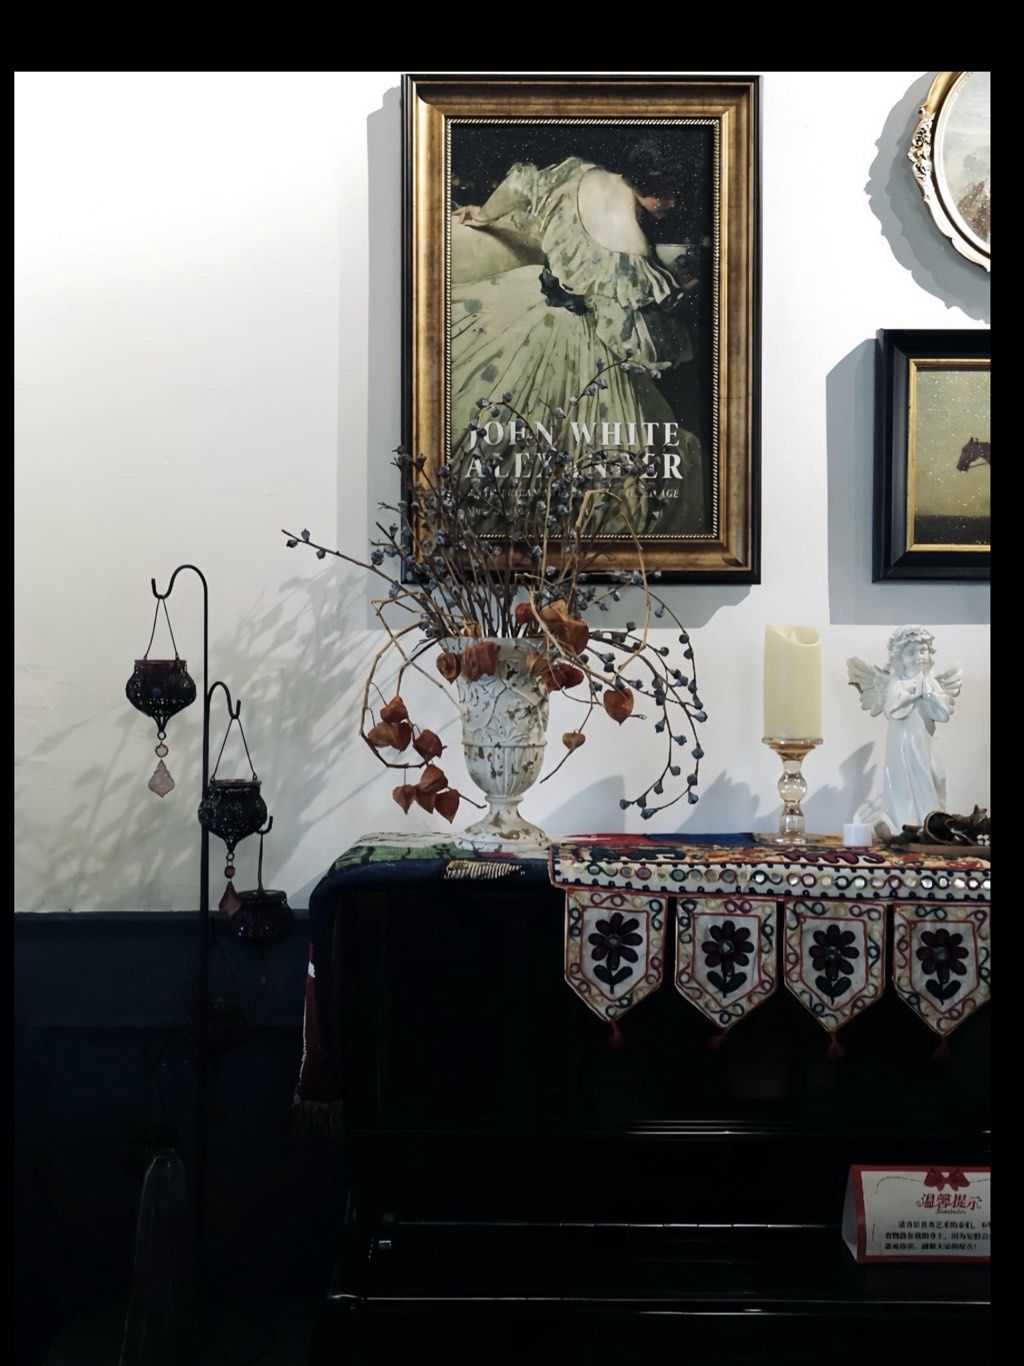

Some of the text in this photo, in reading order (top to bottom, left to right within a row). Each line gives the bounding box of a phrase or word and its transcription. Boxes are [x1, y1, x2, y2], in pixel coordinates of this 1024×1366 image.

[469, 420, 680, 450] JOHN WHITE
[465, 453, 684, 480] ALEXNDER
[921, 1193, 980, 1211] 温馨提示
